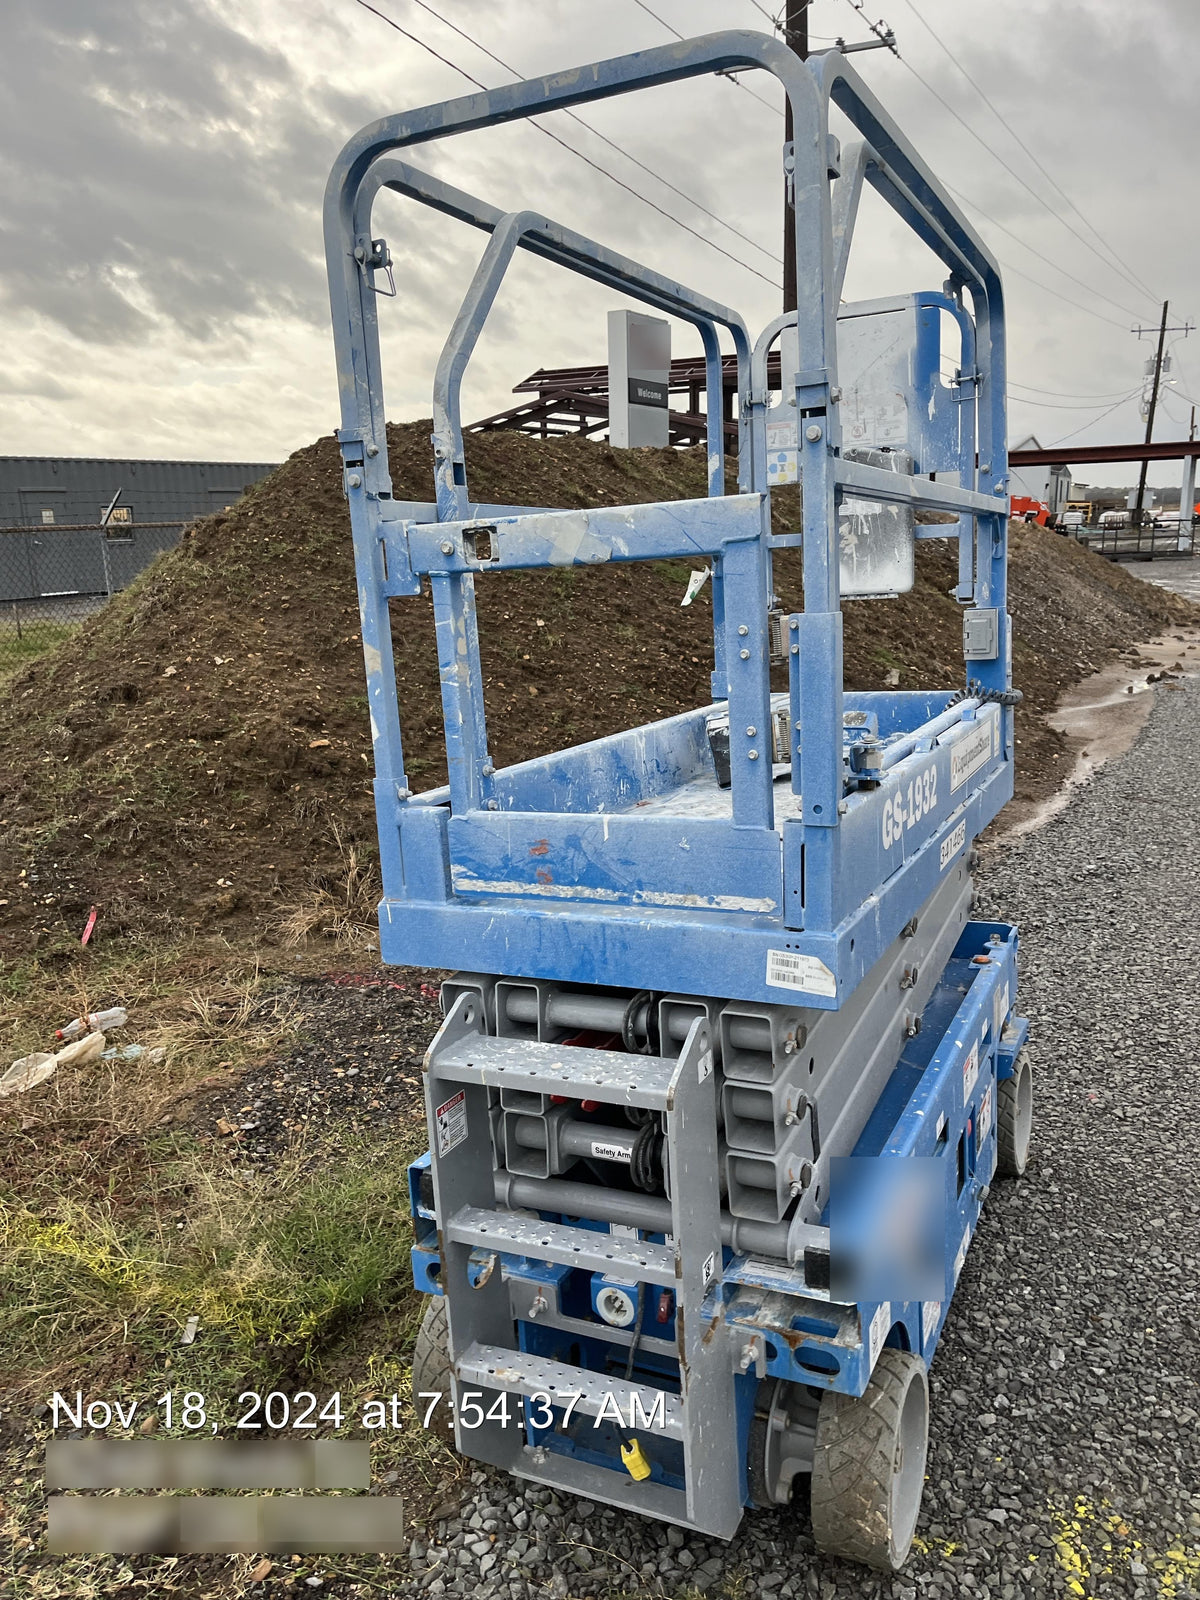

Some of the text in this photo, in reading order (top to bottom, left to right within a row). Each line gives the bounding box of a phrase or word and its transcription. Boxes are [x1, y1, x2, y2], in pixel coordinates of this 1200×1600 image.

[637, 387, 662, 400] Welcome
[882, 764, 938, 850] GS-1932
[443, 1094, 462, 1111] DANGER
[595, 1146, 631, 1159] Safety Arm
